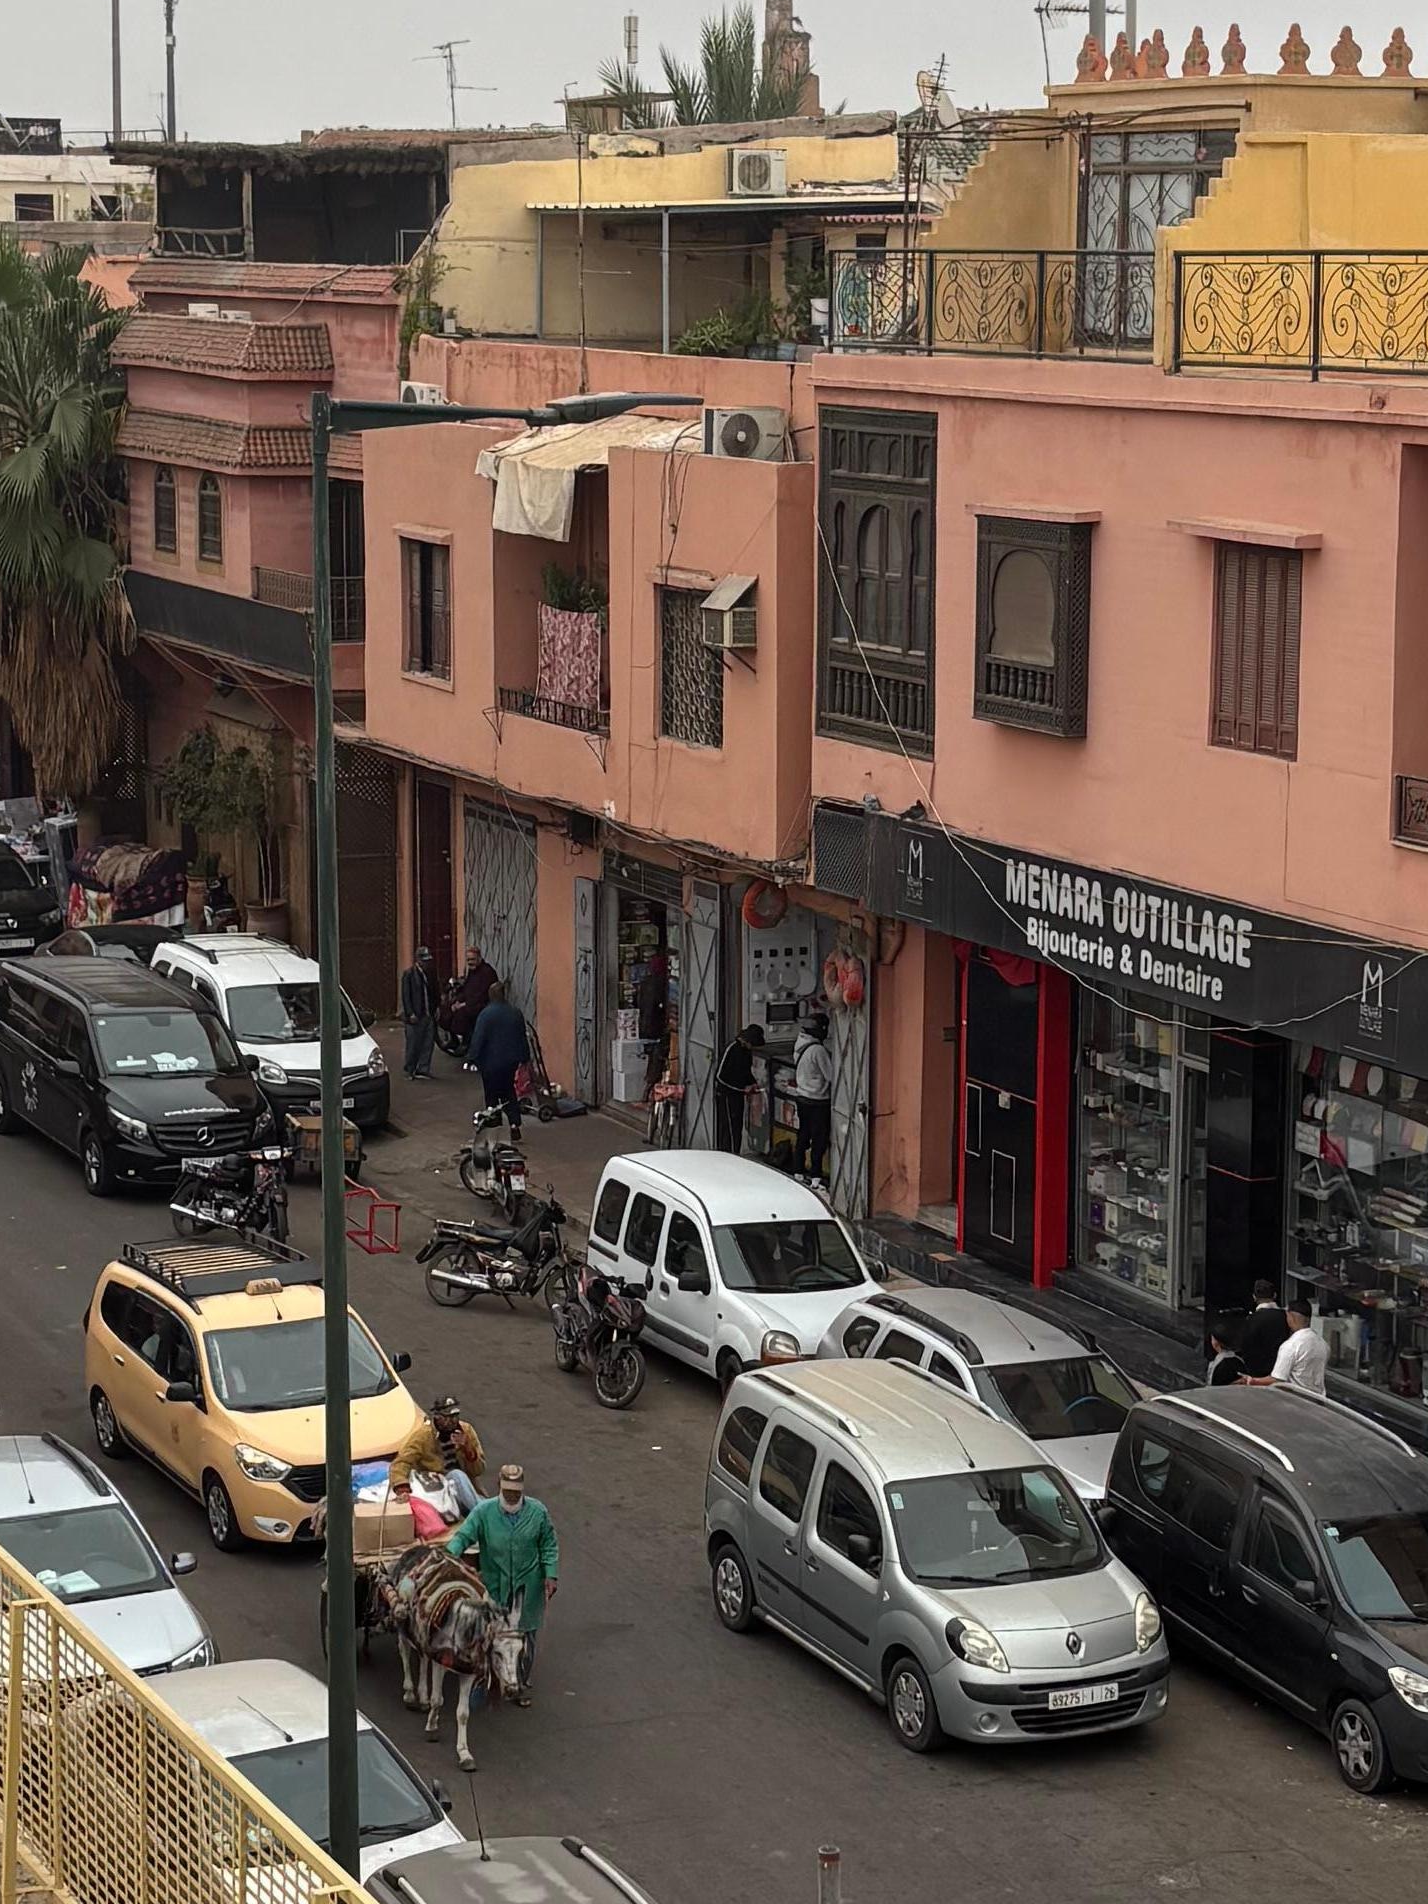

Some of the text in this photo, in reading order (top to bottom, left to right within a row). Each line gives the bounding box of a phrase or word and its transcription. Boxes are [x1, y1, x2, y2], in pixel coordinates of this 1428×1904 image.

[1005, 858, 1254, 969] MENARA OUTILLAGE
[1026, 916, 1223, 1002] Bijouterie & Dentaire
